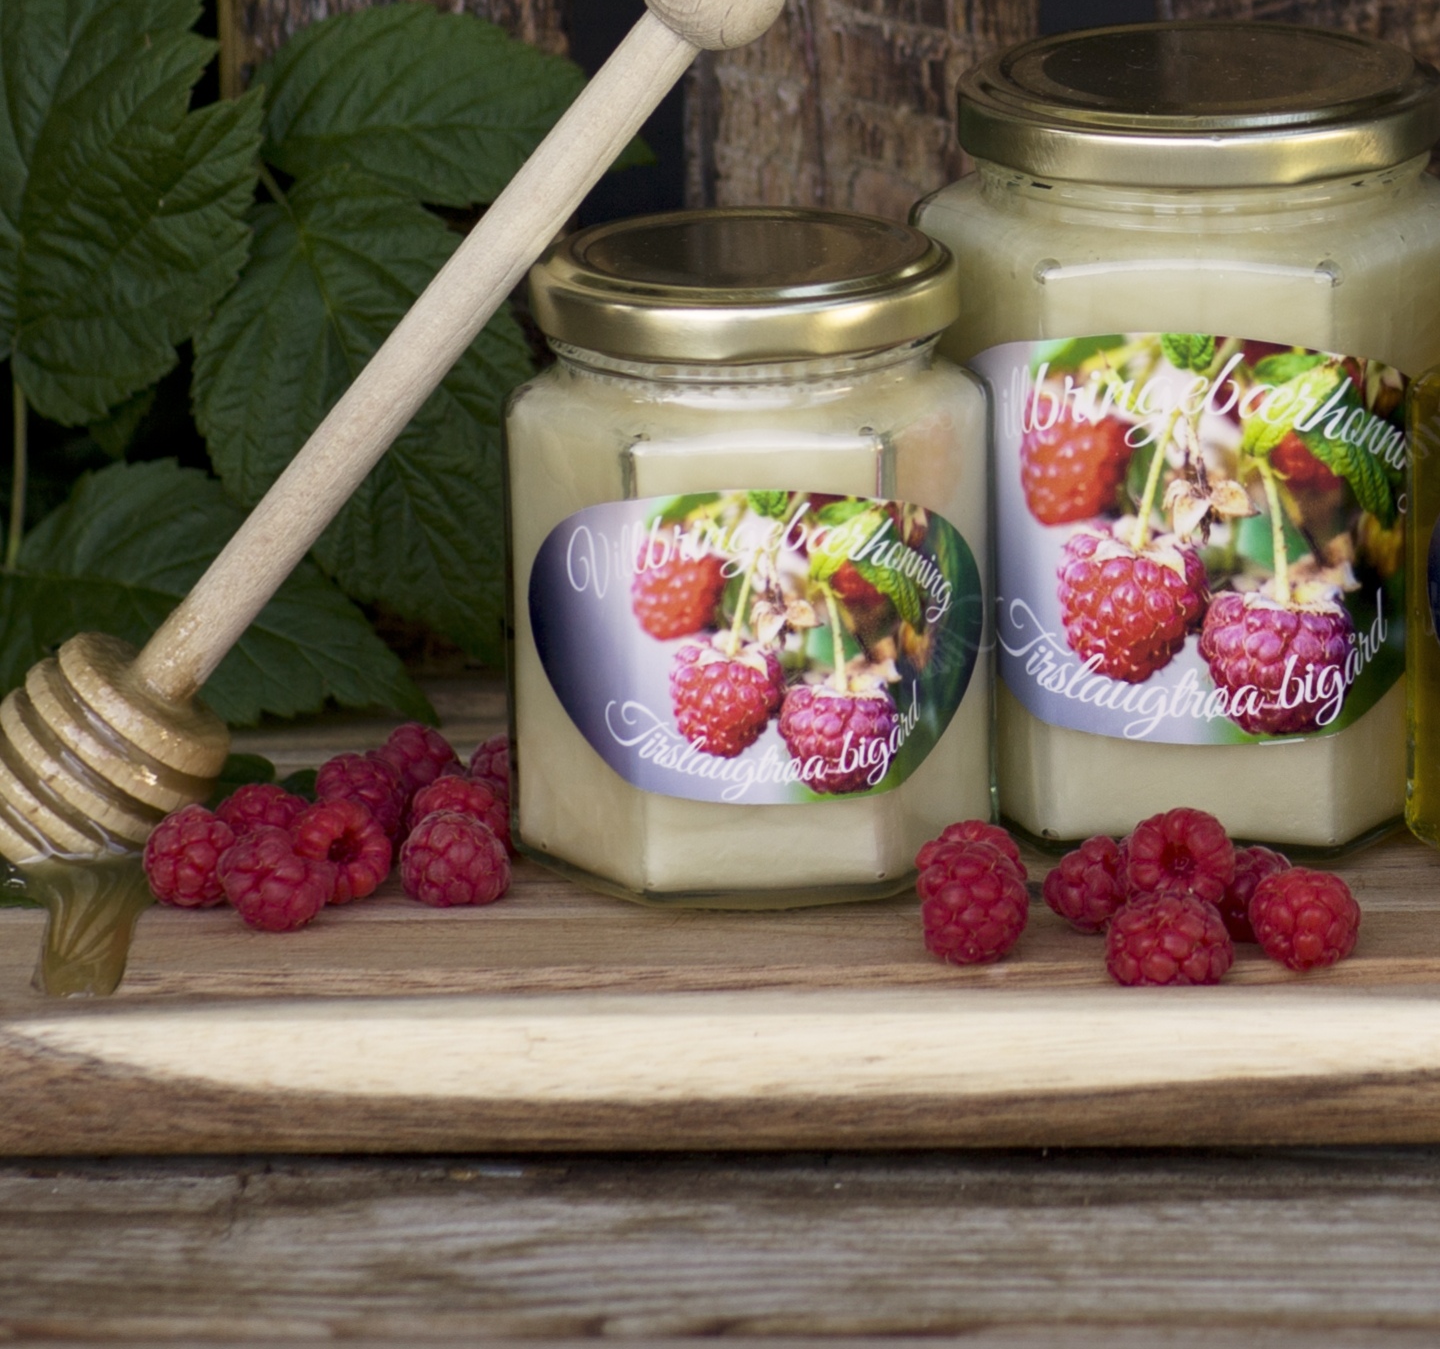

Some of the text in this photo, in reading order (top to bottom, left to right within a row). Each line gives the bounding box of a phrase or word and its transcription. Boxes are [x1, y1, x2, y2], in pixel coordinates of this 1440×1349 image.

[995, 587, 1389, 739] Tirslaugtrøa bigård
[605, 680, 922, 801] Tirslaugtrøa bigård
